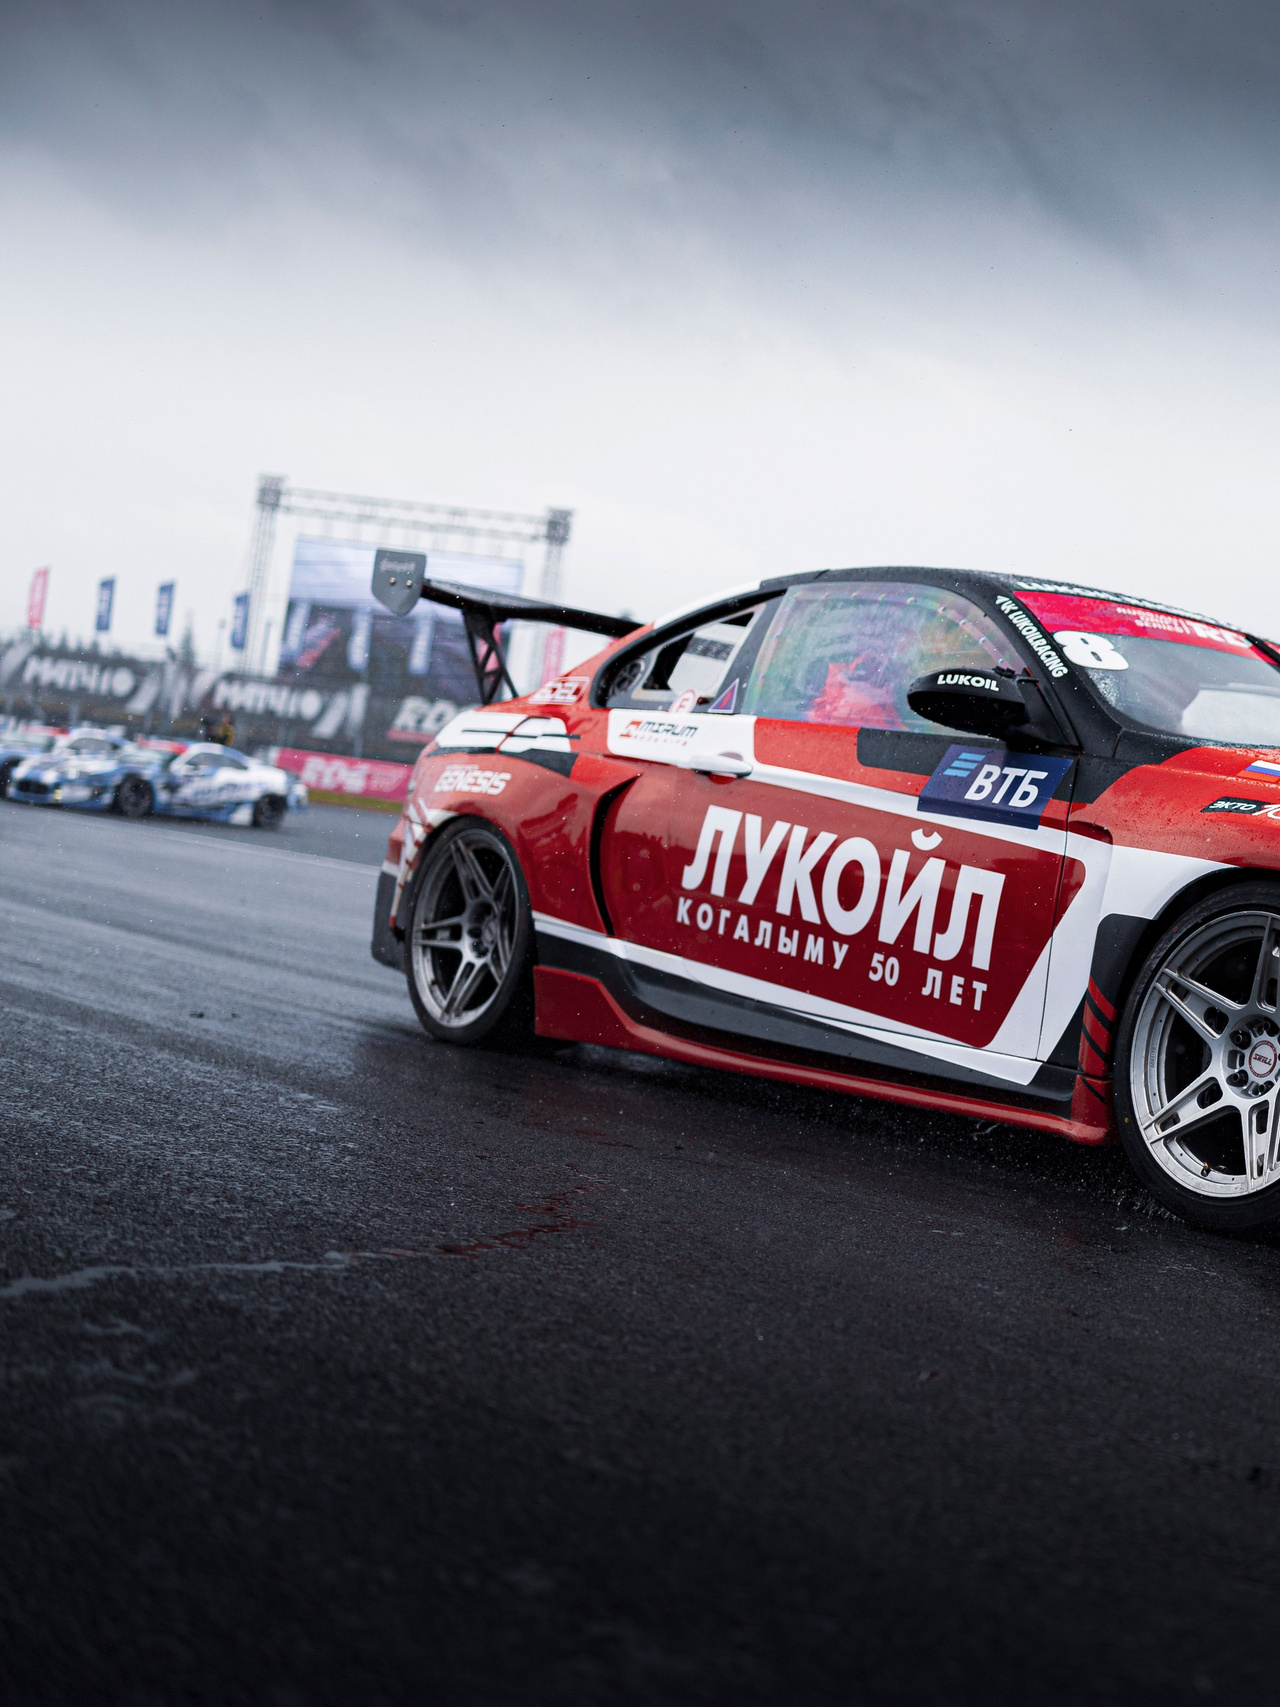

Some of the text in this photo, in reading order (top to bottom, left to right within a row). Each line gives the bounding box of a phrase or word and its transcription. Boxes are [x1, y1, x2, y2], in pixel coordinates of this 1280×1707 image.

[1008, 611, 1068, 678] LUKOILRACING
[1053, 630, 1130, 671] 8
[937, 674, 1000, 692] LUKOIL
[964, 764, 1049, 808] ВТБ
[1209, 801, 1257, 811] ЭКТО
[681, 804, 1006, 971] ЛУКОЙЛ
[676, 897, 988, 1012] КОГАЛЫМУ 50 ЛЕТ
